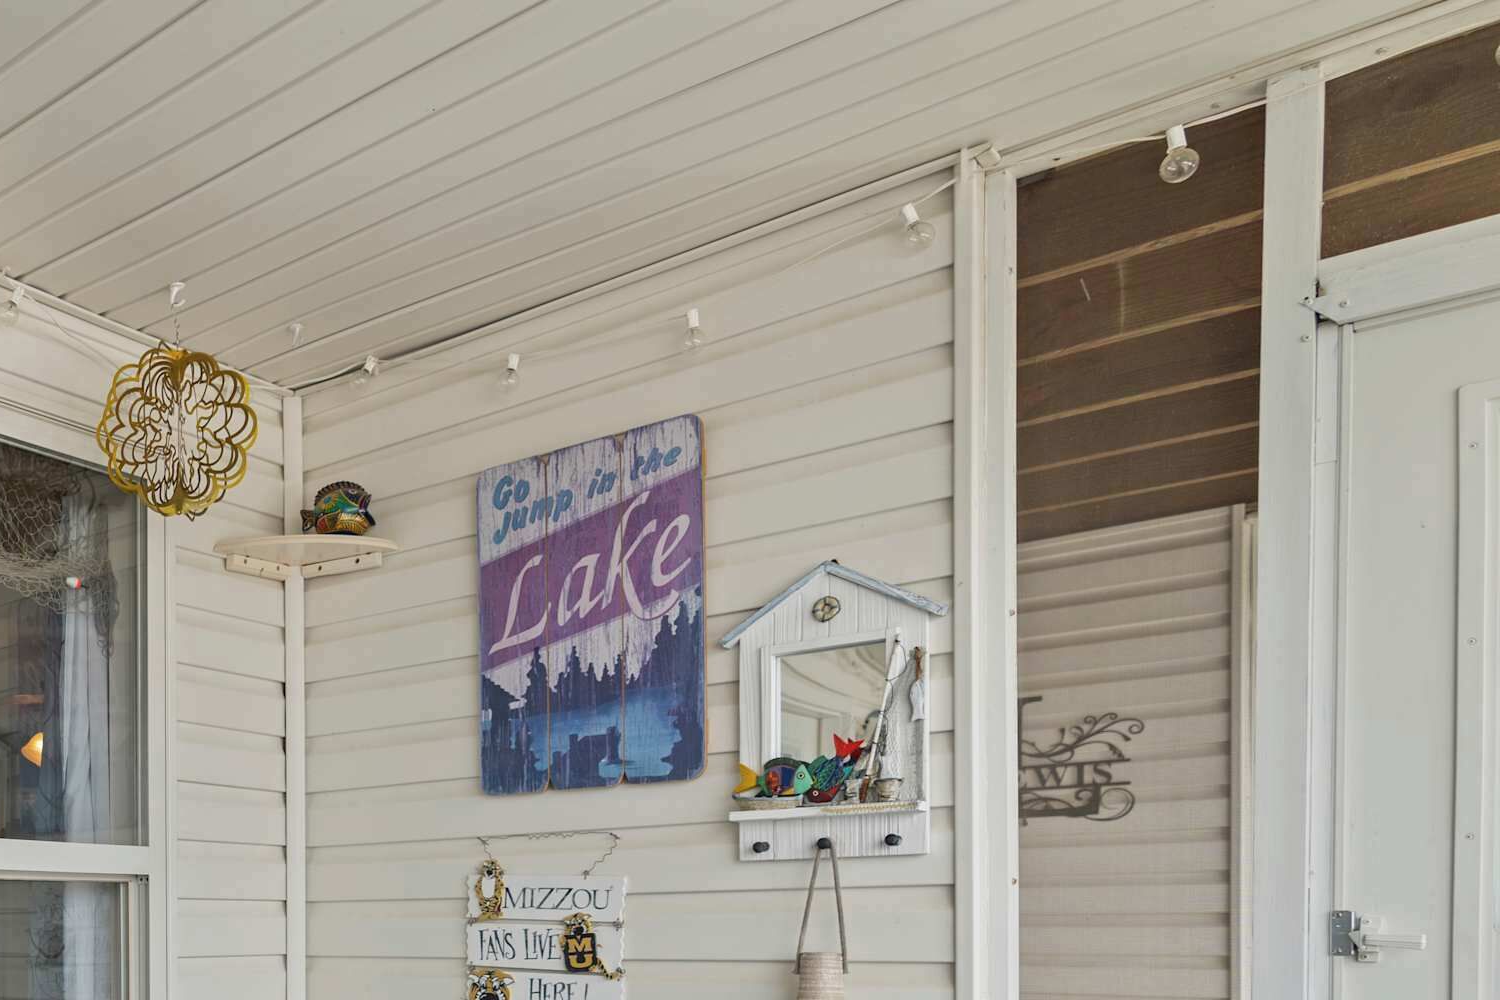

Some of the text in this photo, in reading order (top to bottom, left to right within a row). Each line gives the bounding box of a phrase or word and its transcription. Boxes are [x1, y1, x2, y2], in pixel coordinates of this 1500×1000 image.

[587, 468, 617, 499] in
[629, 446, 683, 482] the
[492, 474, 530, 510] Go
[489, 490, 691, 656] Lake
[503, 886, 612, 910] MIZZOU
[478, 928, 562, 961] FANS LIVE
